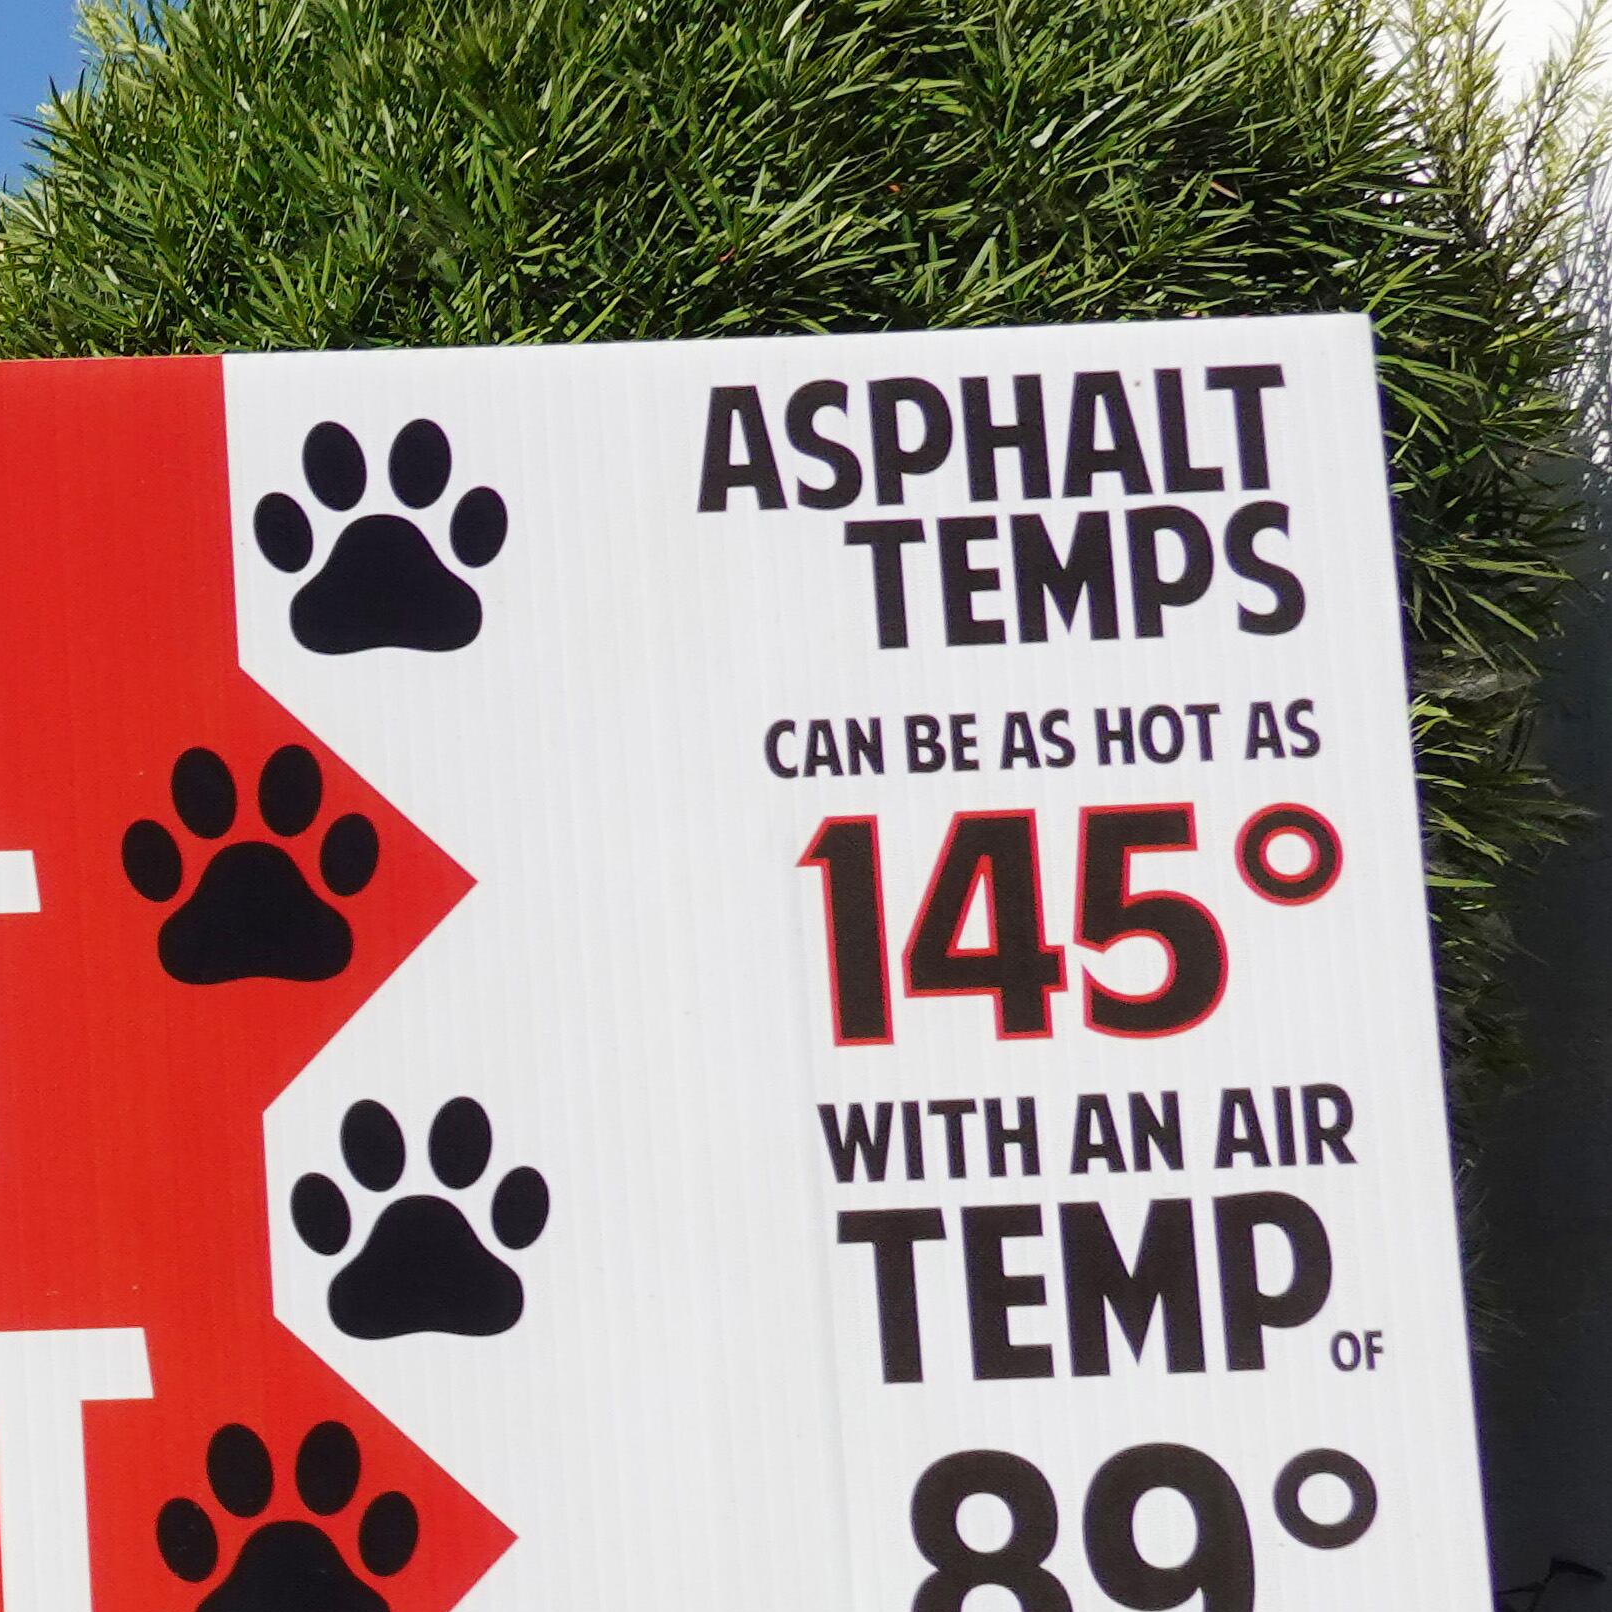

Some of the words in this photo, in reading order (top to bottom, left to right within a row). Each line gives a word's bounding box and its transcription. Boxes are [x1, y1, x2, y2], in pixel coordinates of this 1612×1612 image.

[698, 365, 1284, 512] ASPHALT
[845, 501, 1305, 649] TEMPS
[765, 717, 884, 778] CAN
[906, 714, 980, 773] BE
[1001, 708, 1076, 769] AS
[1095, 703, 1220, 765] HOT
[1246, 699, 1321, 760] AS
[798, 803, 1343, 1046] 145°
[818, 1096, 1041, 1182] WITH
[1071, 1091, 1183, 1173] AN
[1216, 1084, 1356, 1168] AIR
[837, 1192, 1332, 1383] TEMP
[1331, 1331, 1383, 1371] OF
